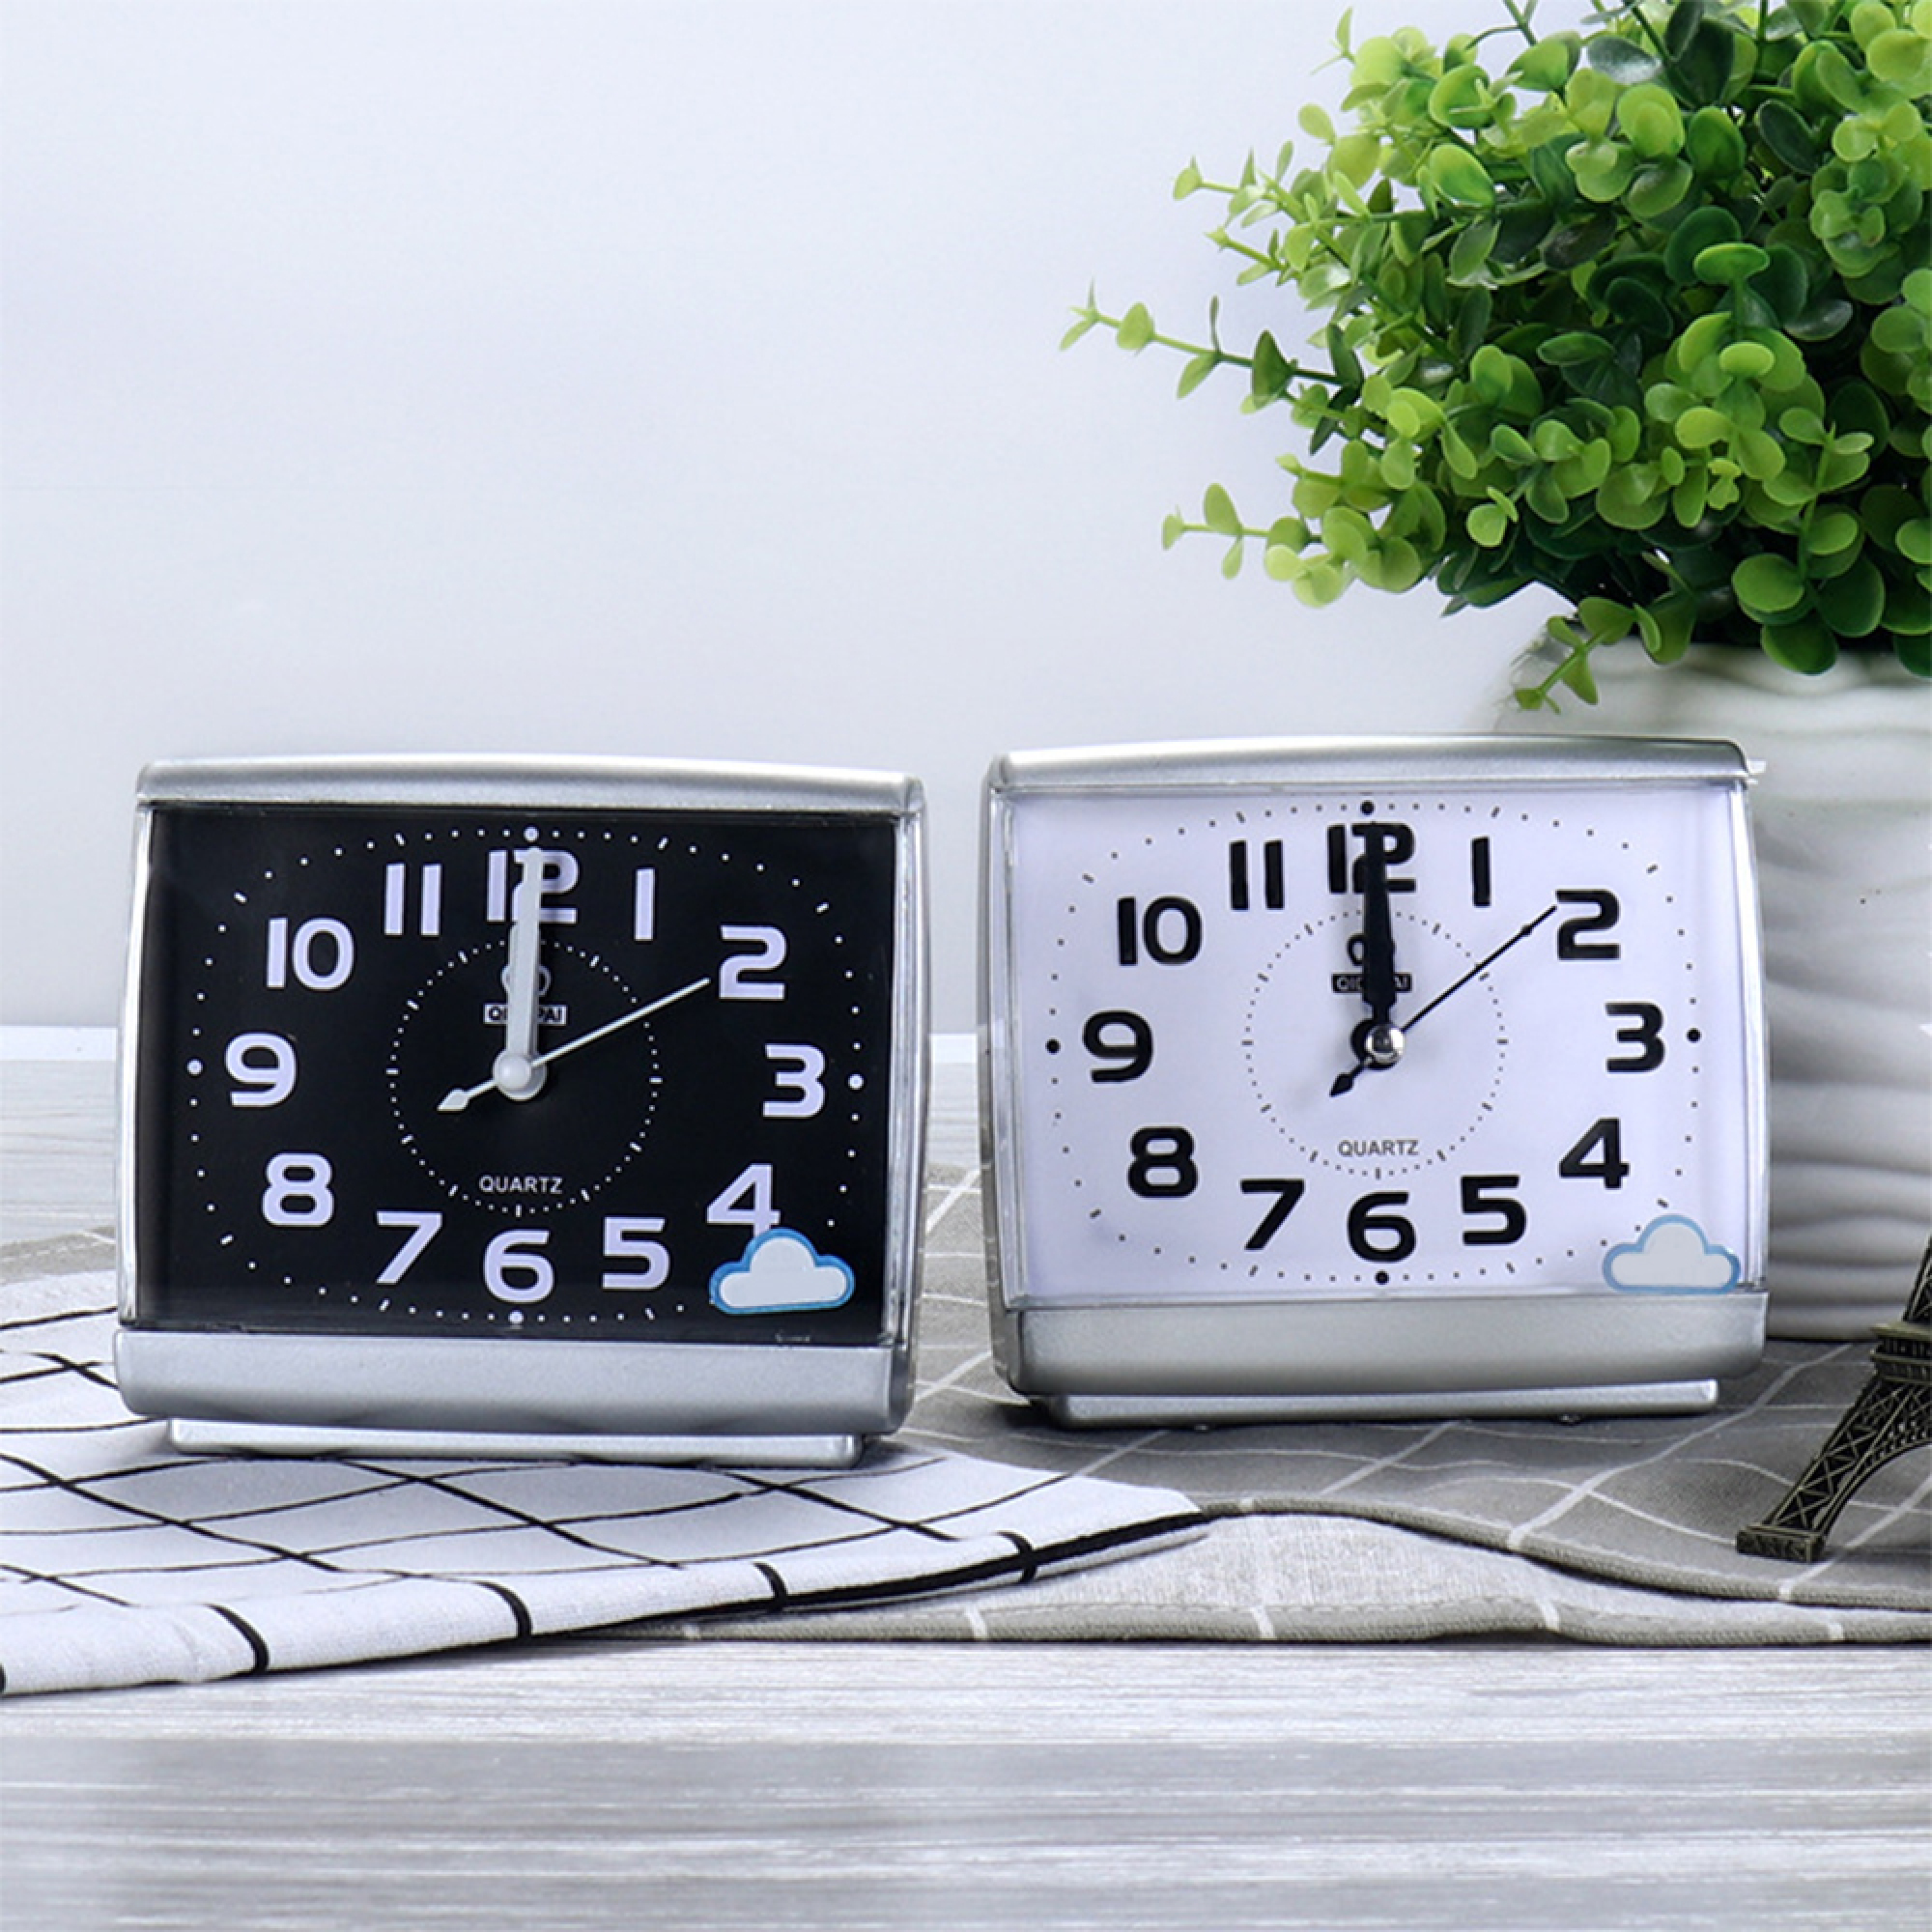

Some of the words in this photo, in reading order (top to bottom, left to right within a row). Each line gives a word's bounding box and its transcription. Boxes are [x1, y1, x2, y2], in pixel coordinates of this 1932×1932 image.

[486, 849, 580, 923] 12
[1230, 839, 1284, 911] 11
[1327, 823, 1417, 895] 12
[1471, 836, 1491, 907] 1
[384, 863, 441, 936] 11
[635, 868, 654, 940] 1
[1118, 895, 1203, 967] 10
[1556, 889, 1620, 961] 2
[266, 917, 355, 990] 10
[720, 924, 787, 1000] 2
[225, 1033, 297, 1108] 9
[1081, 1009, 1154, 1083] 9
[1606, 1002, 1664, 1073] 3
[762, 1044, 825, 1118] 3
[1127, 1127, 1199, 1199] 8
[1338, 1138, 1420, 1158] QUARTZ
[1558, 1118, 1630, 1189] 4
[262, 1152, 333, 1226] 8
[478, 1175, 563, 1195] QUARTZ
[706, 1163, 781, 1237] 4
[1239, 1178, 1305, 1251] 7
[1460, 1174, 1527, 1245] 5
[376, 1210, 441, 1284] 7
[602, 1216, 669, 1290] 5
[1348, 1191, 1417, 1263] 6
[484, 1230, 554, 1303] 6
